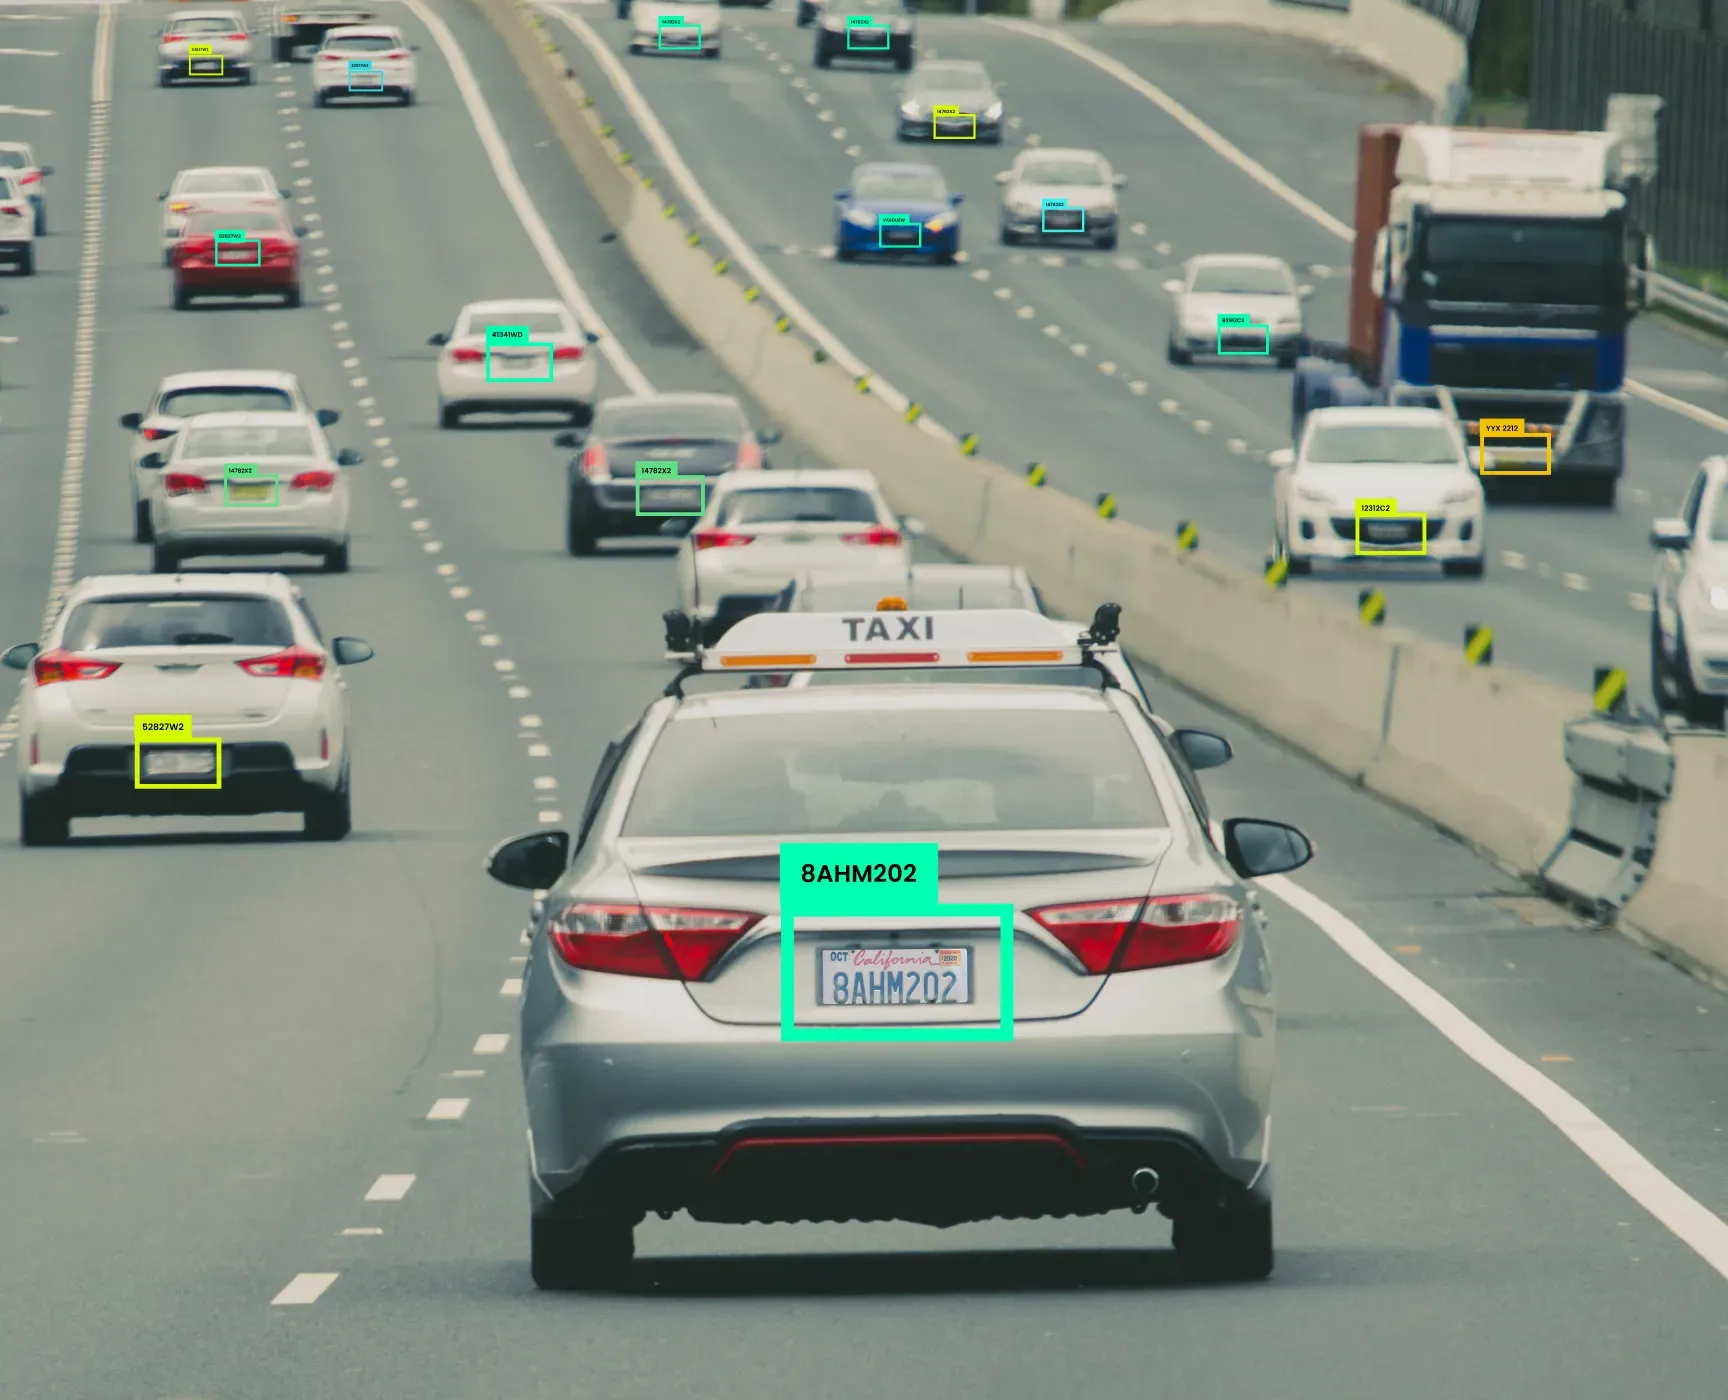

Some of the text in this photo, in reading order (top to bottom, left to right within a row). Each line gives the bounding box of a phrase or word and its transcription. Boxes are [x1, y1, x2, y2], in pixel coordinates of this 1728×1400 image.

[842, 616, 934, 642] TAXI
[830, 951, 849, 962] OCT
[853, 949, 939, 971] California
[833, 971, 957, 1005] 8AHM202
